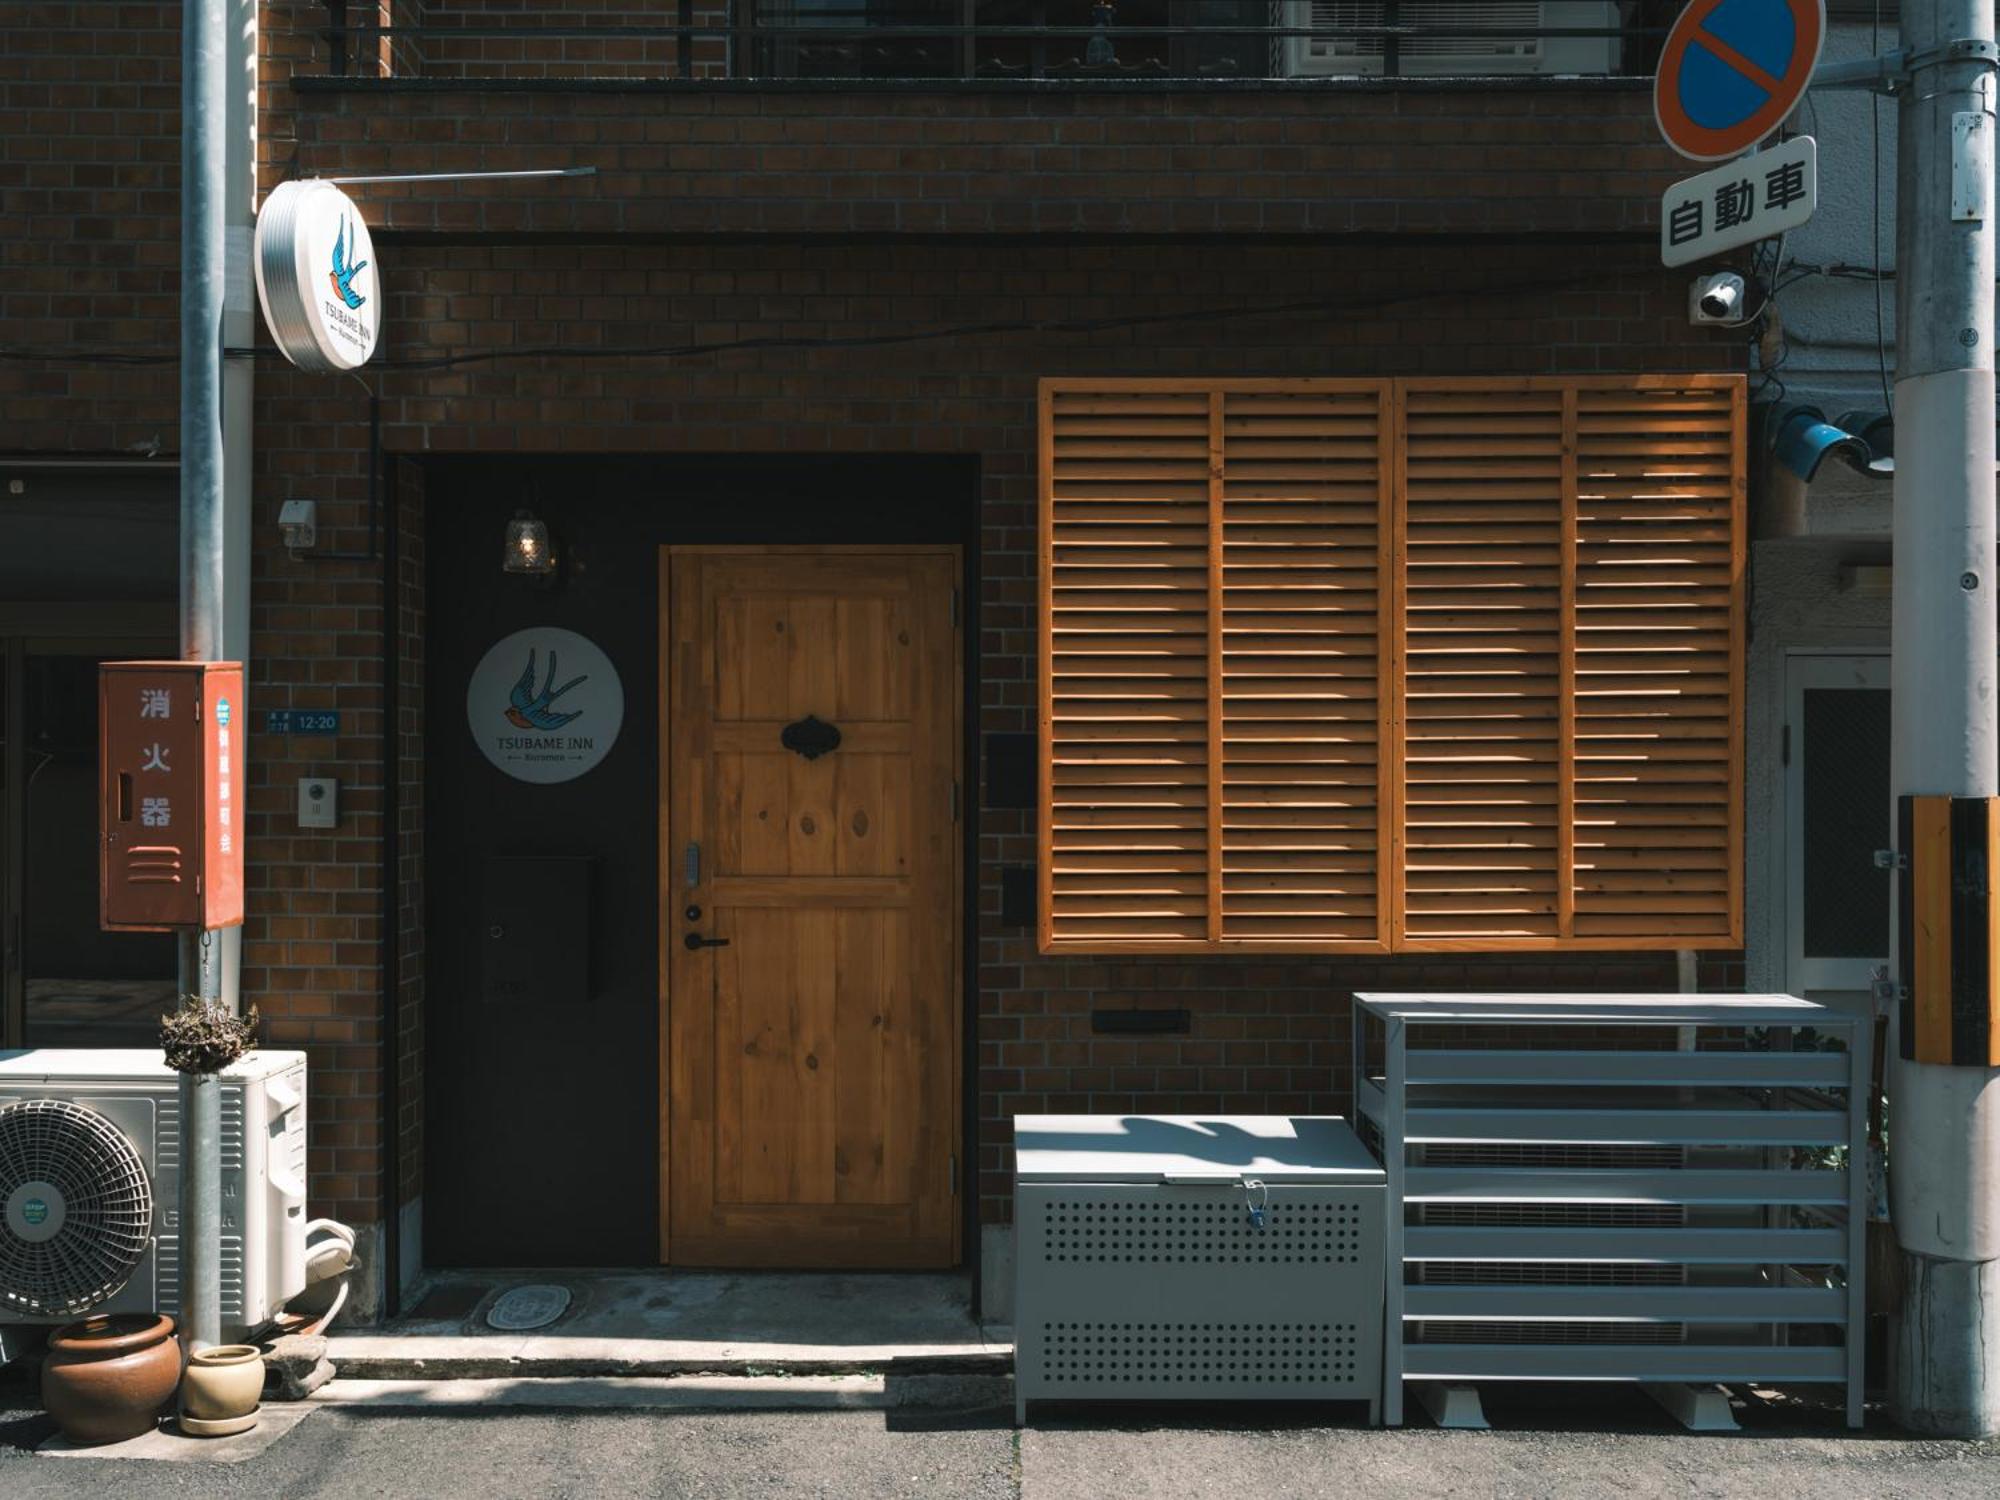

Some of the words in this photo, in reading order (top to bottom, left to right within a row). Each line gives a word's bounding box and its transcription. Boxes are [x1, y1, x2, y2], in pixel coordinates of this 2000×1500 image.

[1669, 160, 1806, 246] 自動車
[325, 301, 358, 333] TSUBAME
[300, 716, 336, 729] 12-20
[140, 689, 171, 827] 消火器
[497, 737, 563, 750] TSUBAME
[567, 737, 593, 750] INN
